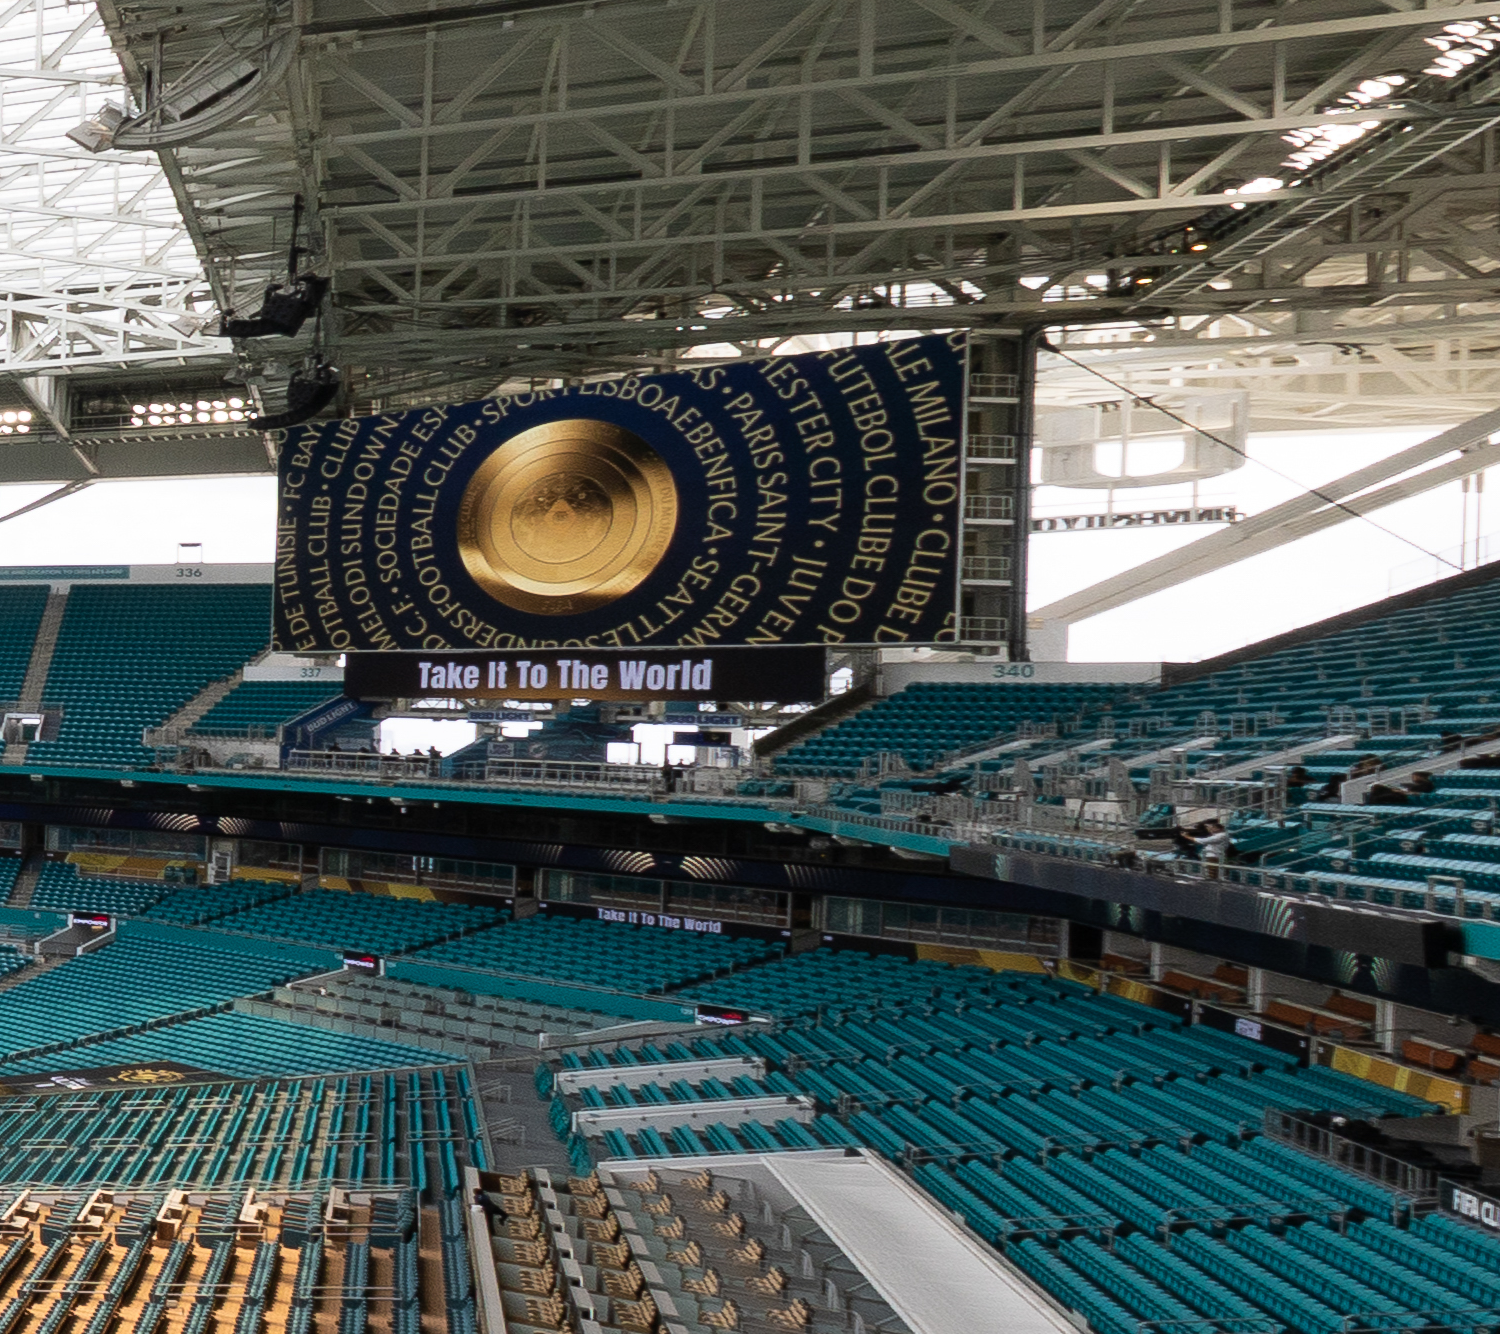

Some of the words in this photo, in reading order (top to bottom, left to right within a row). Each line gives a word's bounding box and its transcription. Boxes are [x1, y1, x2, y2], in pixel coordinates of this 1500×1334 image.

[321, 418, 360, 479] CLUB
[423, 424, 478, 487] CLUB
[723, 392, 784, 469] PARIS
[905, 379, 959, 506] MILANO
[283, 472, 306, 500] FC
[374, 440, 423, 583] SOCIEDADE
[688, 421, 739, 543] BENFICA
[808, 457, 844, 533] CITY
[308, 495, 332, 557] CLUB
[411, 489, 460, 618] FOOTBALL
[850, 475, 900, 572] CLUBE
[175, 568, 203, 579] 336
[278, 516, 299, 604] TUNISIE
[886, 528, 952, 625] CLUBE
[285, 603, 306, 636] DE
[309, 558, 358, 651] OTBALL
[602, 555, 719, 648] SEATTLE
[828, 575, 876, 625] DO
[300, 667, 321, 678] 337
[418, 661, 480, 689] Take
[487, 661, 508, 689] It
[516, 660, 548, 689] To
[557, 659, 609, 690] The
[618, 658, 713, 691] World
[990, 664, 1034, 679] 340
[597, 906, 626, 923] Take
[682, 917, 721, 934] World
